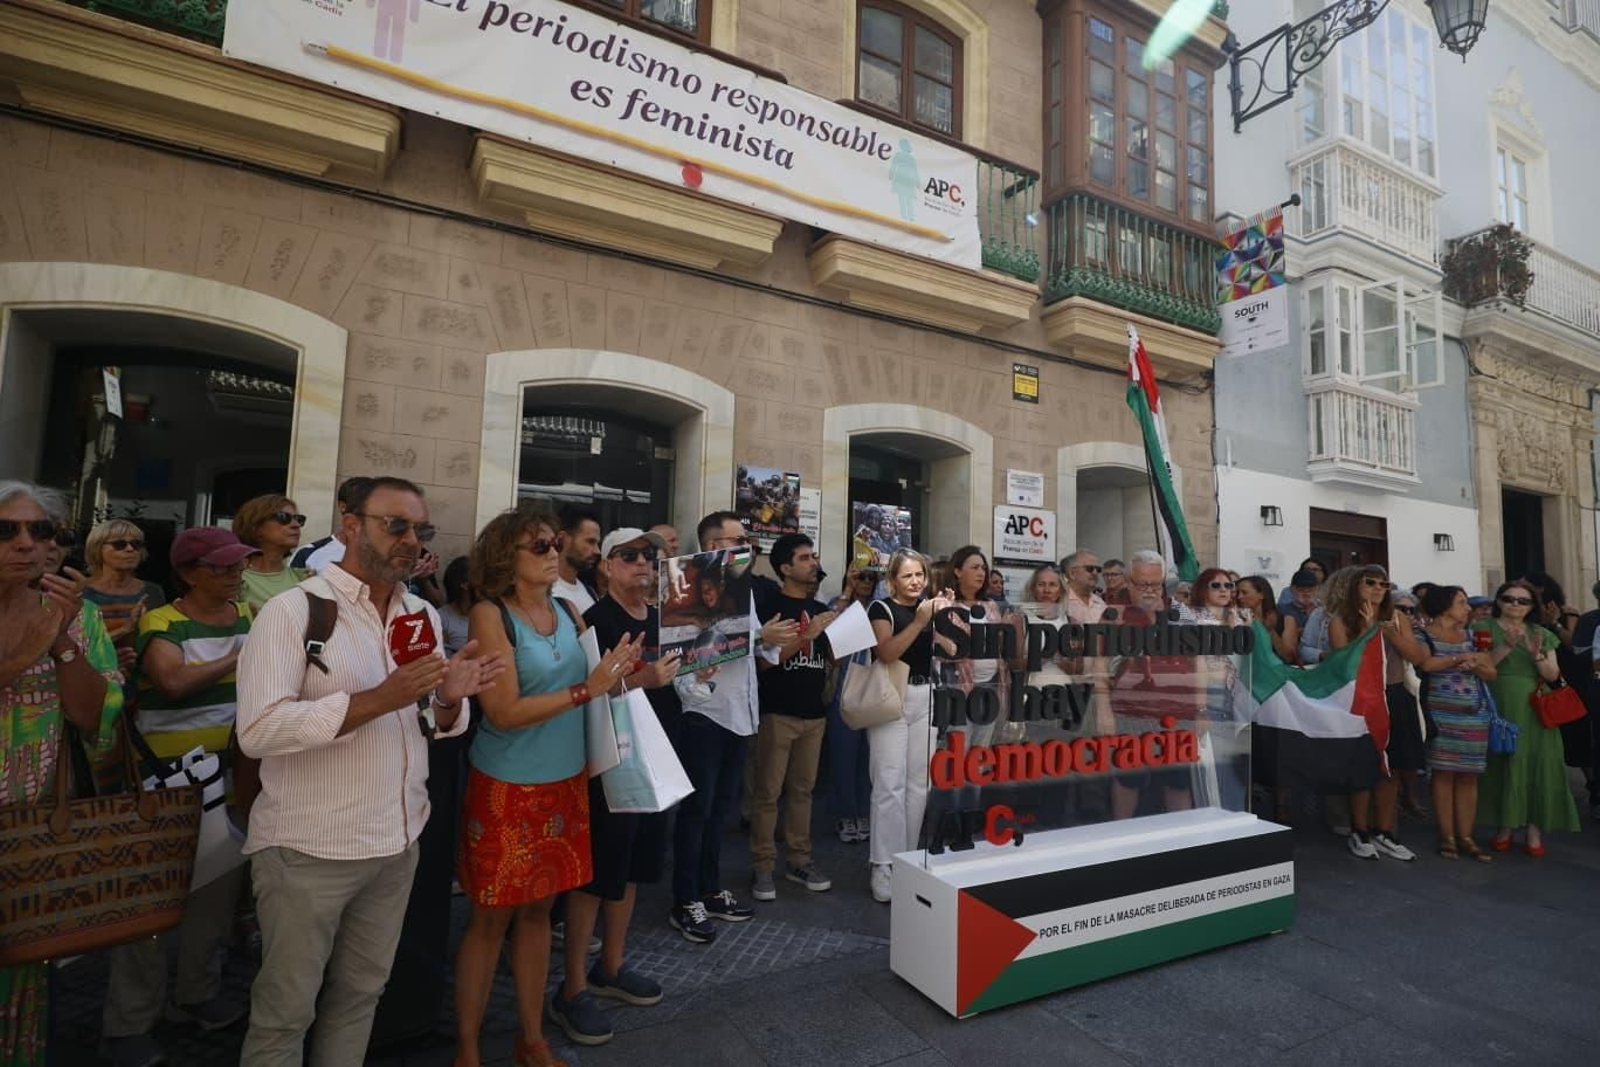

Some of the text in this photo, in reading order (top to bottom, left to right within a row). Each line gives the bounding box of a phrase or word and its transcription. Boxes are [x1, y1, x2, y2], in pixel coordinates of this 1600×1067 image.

[478, 0, 893, 161] periodismo responsable
[570, 78, 795, 171] es feminista
[1235, 300, 1269, 318] SOUTH
[404, 619, 425, 645] 7
[932, 604, 1255, 673] Sin periodismo
[931, 668, 1094, 731] no hay
[930, 714, 1200, 791] democracia
[1039, 873, 1291, 939] POR EL FIN DE LA MASACRE DELIBERADA DE PERIODISTAS EN GAZA
